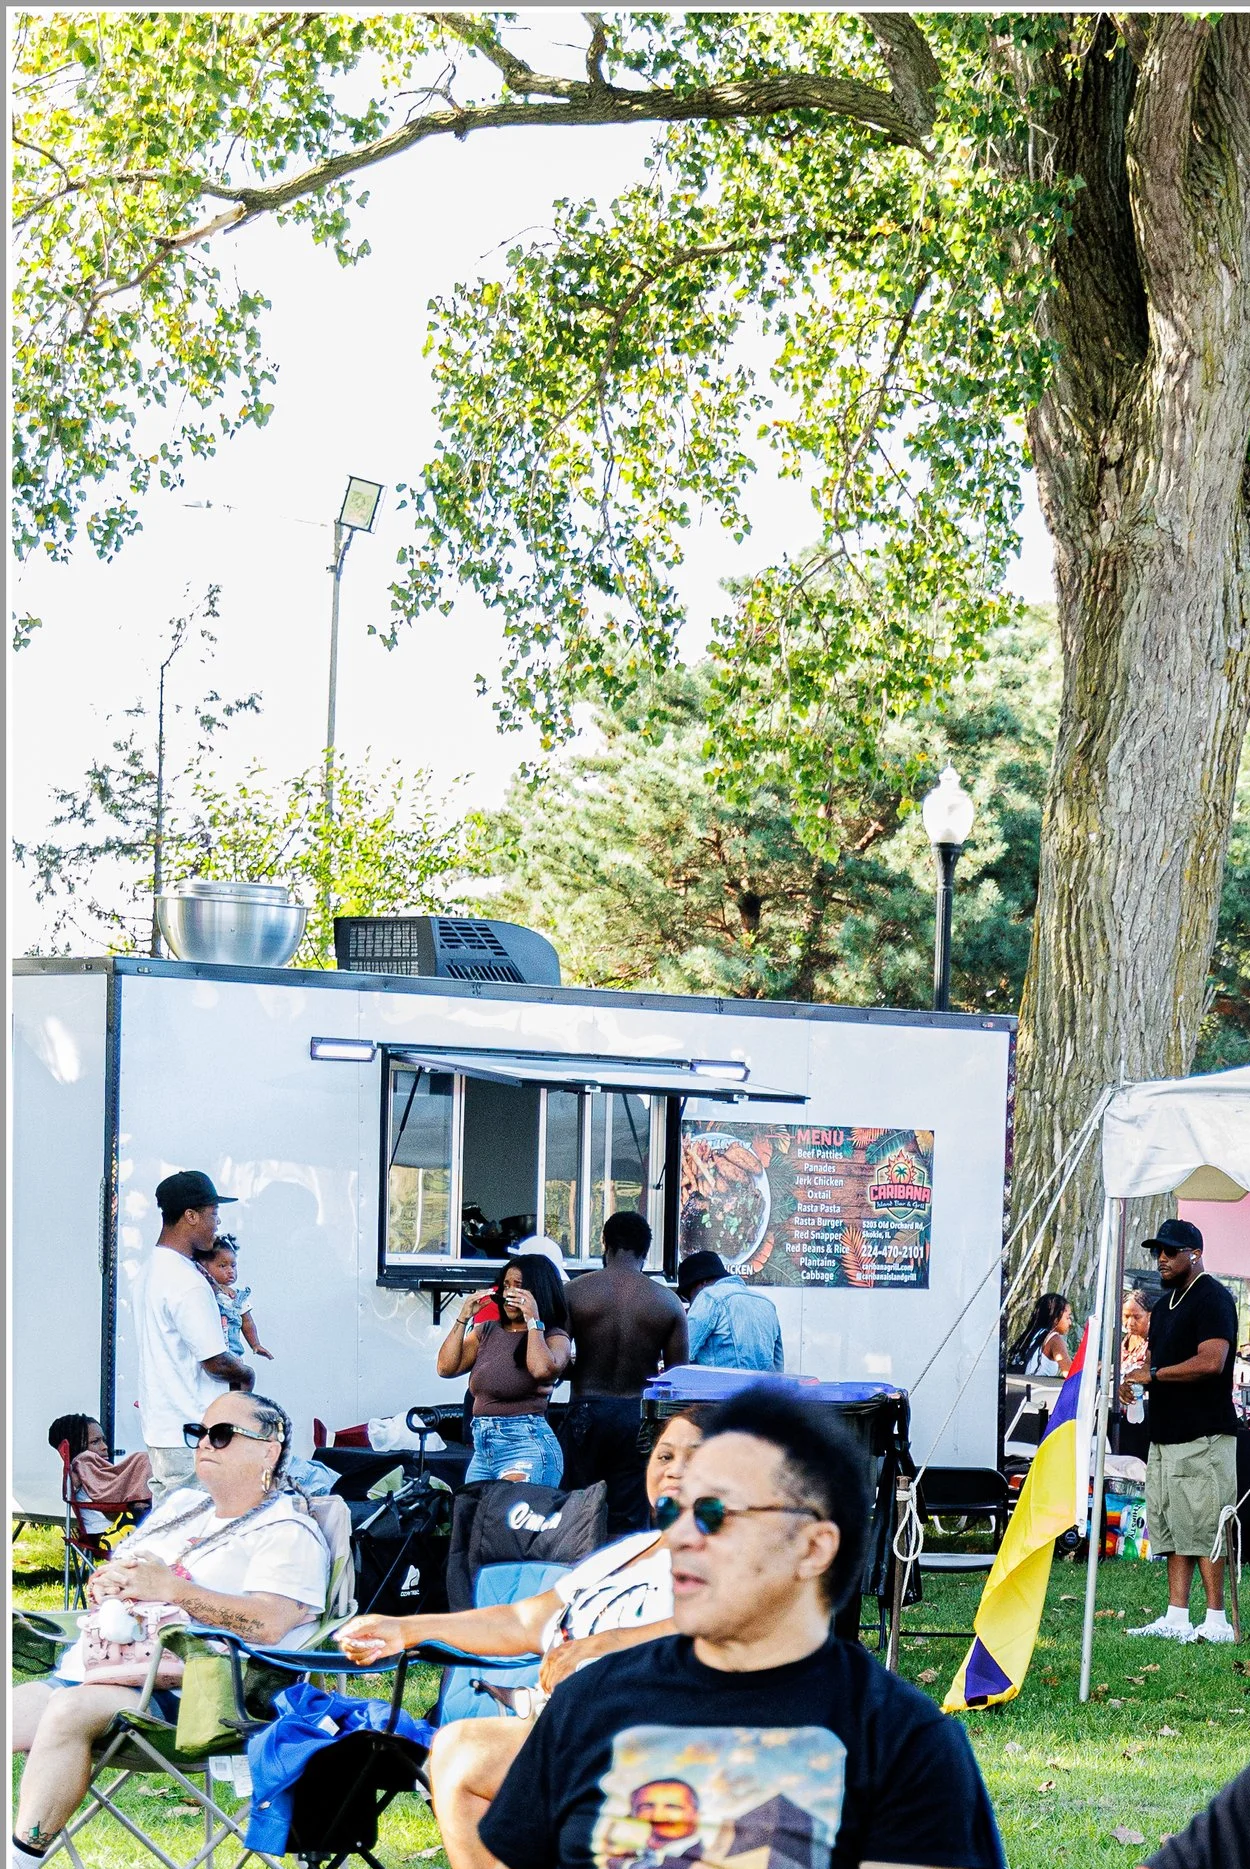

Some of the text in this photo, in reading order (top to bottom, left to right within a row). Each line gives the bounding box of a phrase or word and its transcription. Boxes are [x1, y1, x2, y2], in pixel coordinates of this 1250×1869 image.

[796, 1129, 844, 1146] MENU
[797, 1149, 843, 1159] Beef Patties
[804, 1163, 836, 1173] Panades
[795, 1176, 843, 1186] Jerk Chicken
[807, 1190, 831, 1199] Oxtail
[870, 1185, 931, 1203] CARIBANA
[797, 1203, 841, 1213] Rasta Pasta
[912, 1201, 925, 1209] Grill
[794, 1217, 844, 1228] Rasta Burger
[794, 1230, 843, 1241] Red Snapper
[785, 1243, 850, 1254] Red Beans & Rice
[861, 1245, 924, 1259] 224-470-2101
[799, 1257, 836, 1266] Plantains
[801, 1270, 834, 1282] Cabbage
